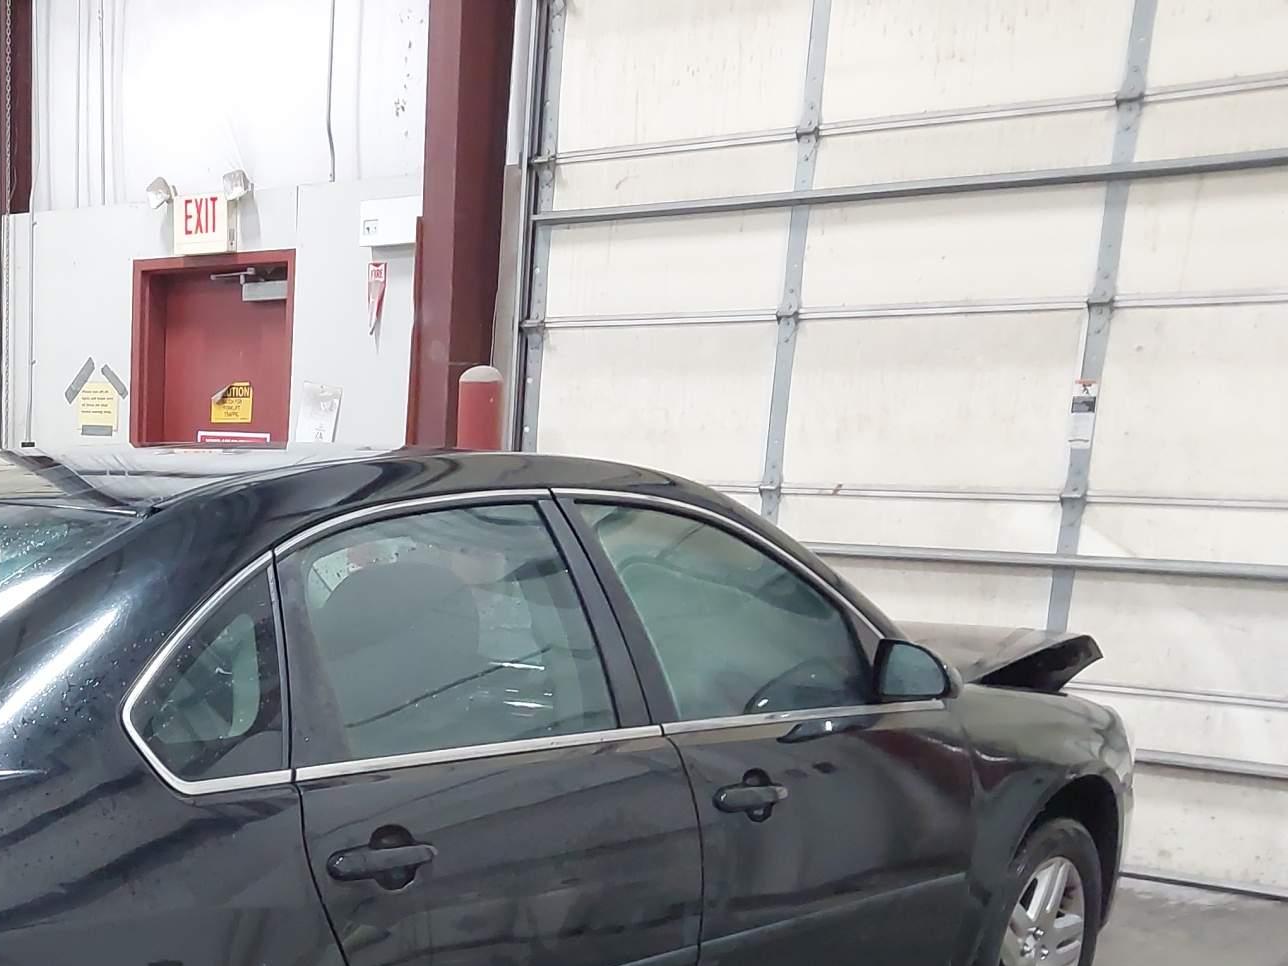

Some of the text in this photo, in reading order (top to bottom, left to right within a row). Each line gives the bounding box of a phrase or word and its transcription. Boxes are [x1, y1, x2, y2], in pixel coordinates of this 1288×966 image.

[184, 196, 218, 235] EXIT
[370, 269, 383, 279] FIRE
[226, 386, 250, 397] UTION
